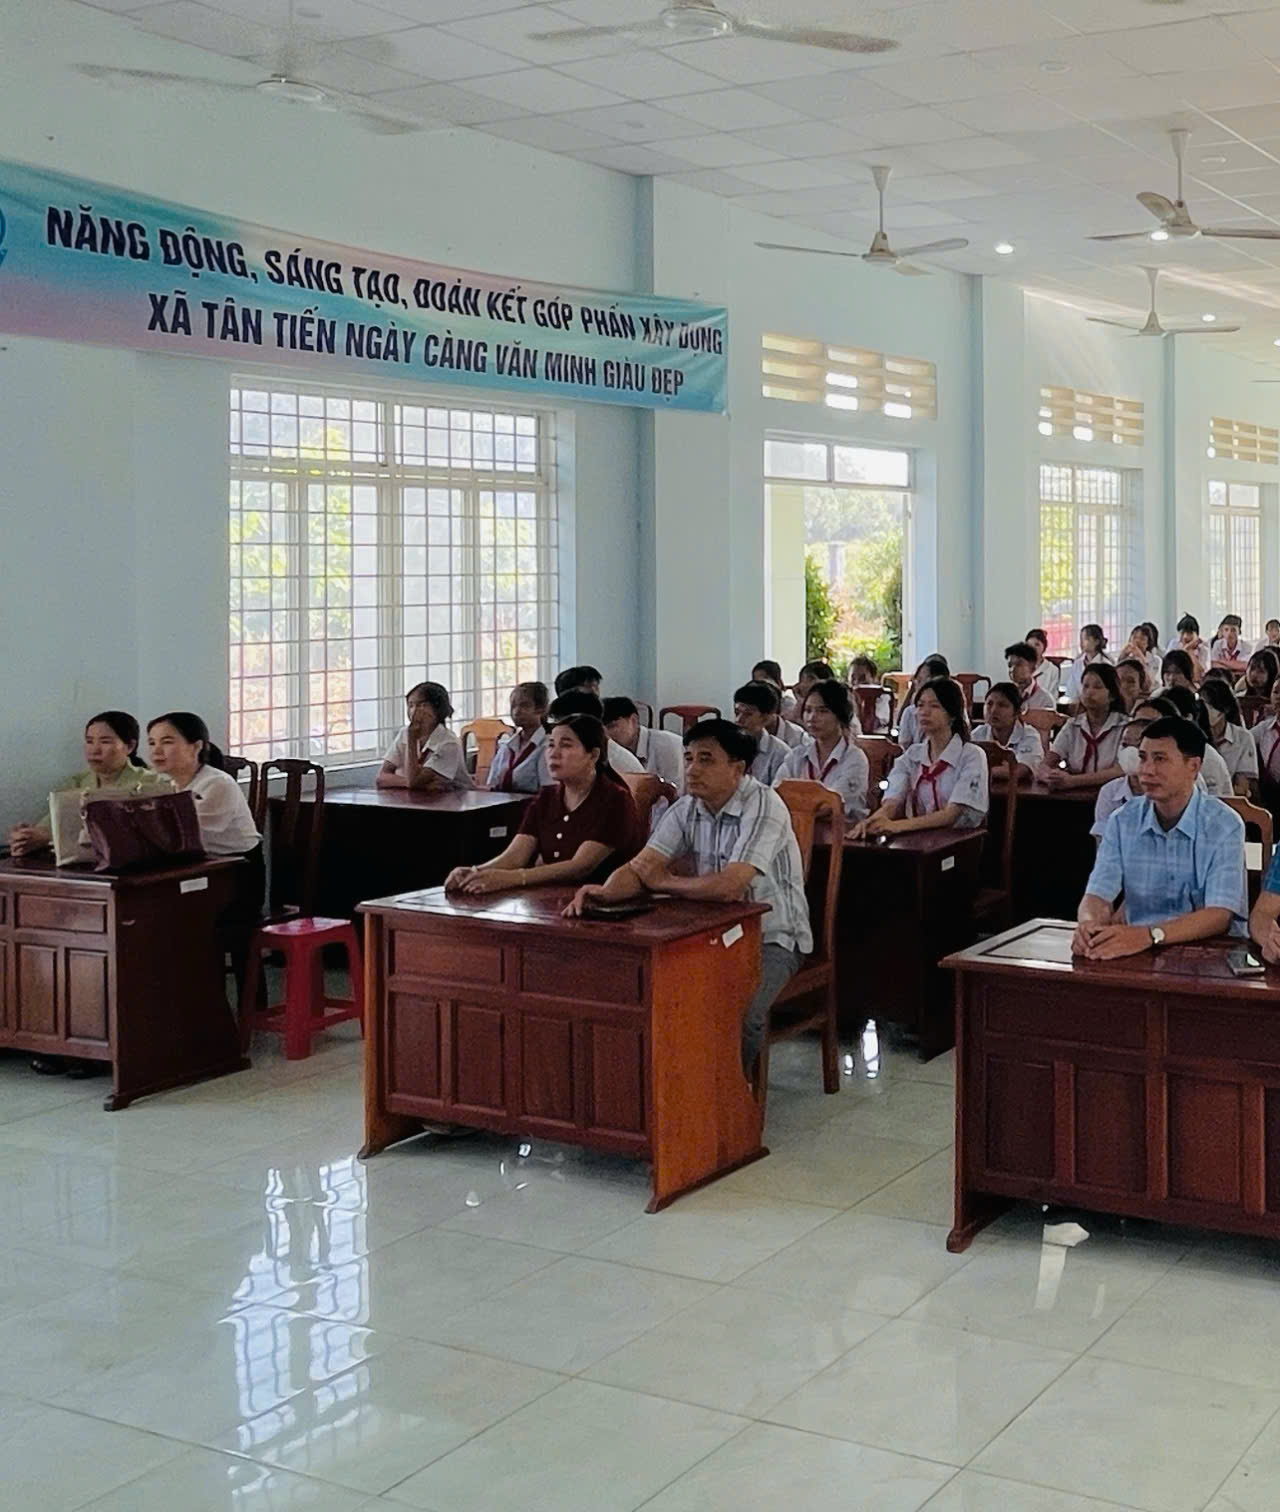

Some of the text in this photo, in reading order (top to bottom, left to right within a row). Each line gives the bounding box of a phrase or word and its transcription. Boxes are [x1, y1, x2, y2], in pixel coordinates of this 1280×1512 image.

[47, 204, 149, 261] NĂNG
[159, 226, 258, 284] ĐỘNG,
[265, 248, 344, 295] SÁNG
[352, 266, 408, 309] TẠO,
[487, 285, 527, 324] KẾT
[533, 296, 573, 331] GÓP
[639, 313, 674, 347] XÂY
[148, 290, 684, 401] XÃ TÂN TIẾN NGÀY CÀNG VĂN MINH GIÀU ĐẸP
